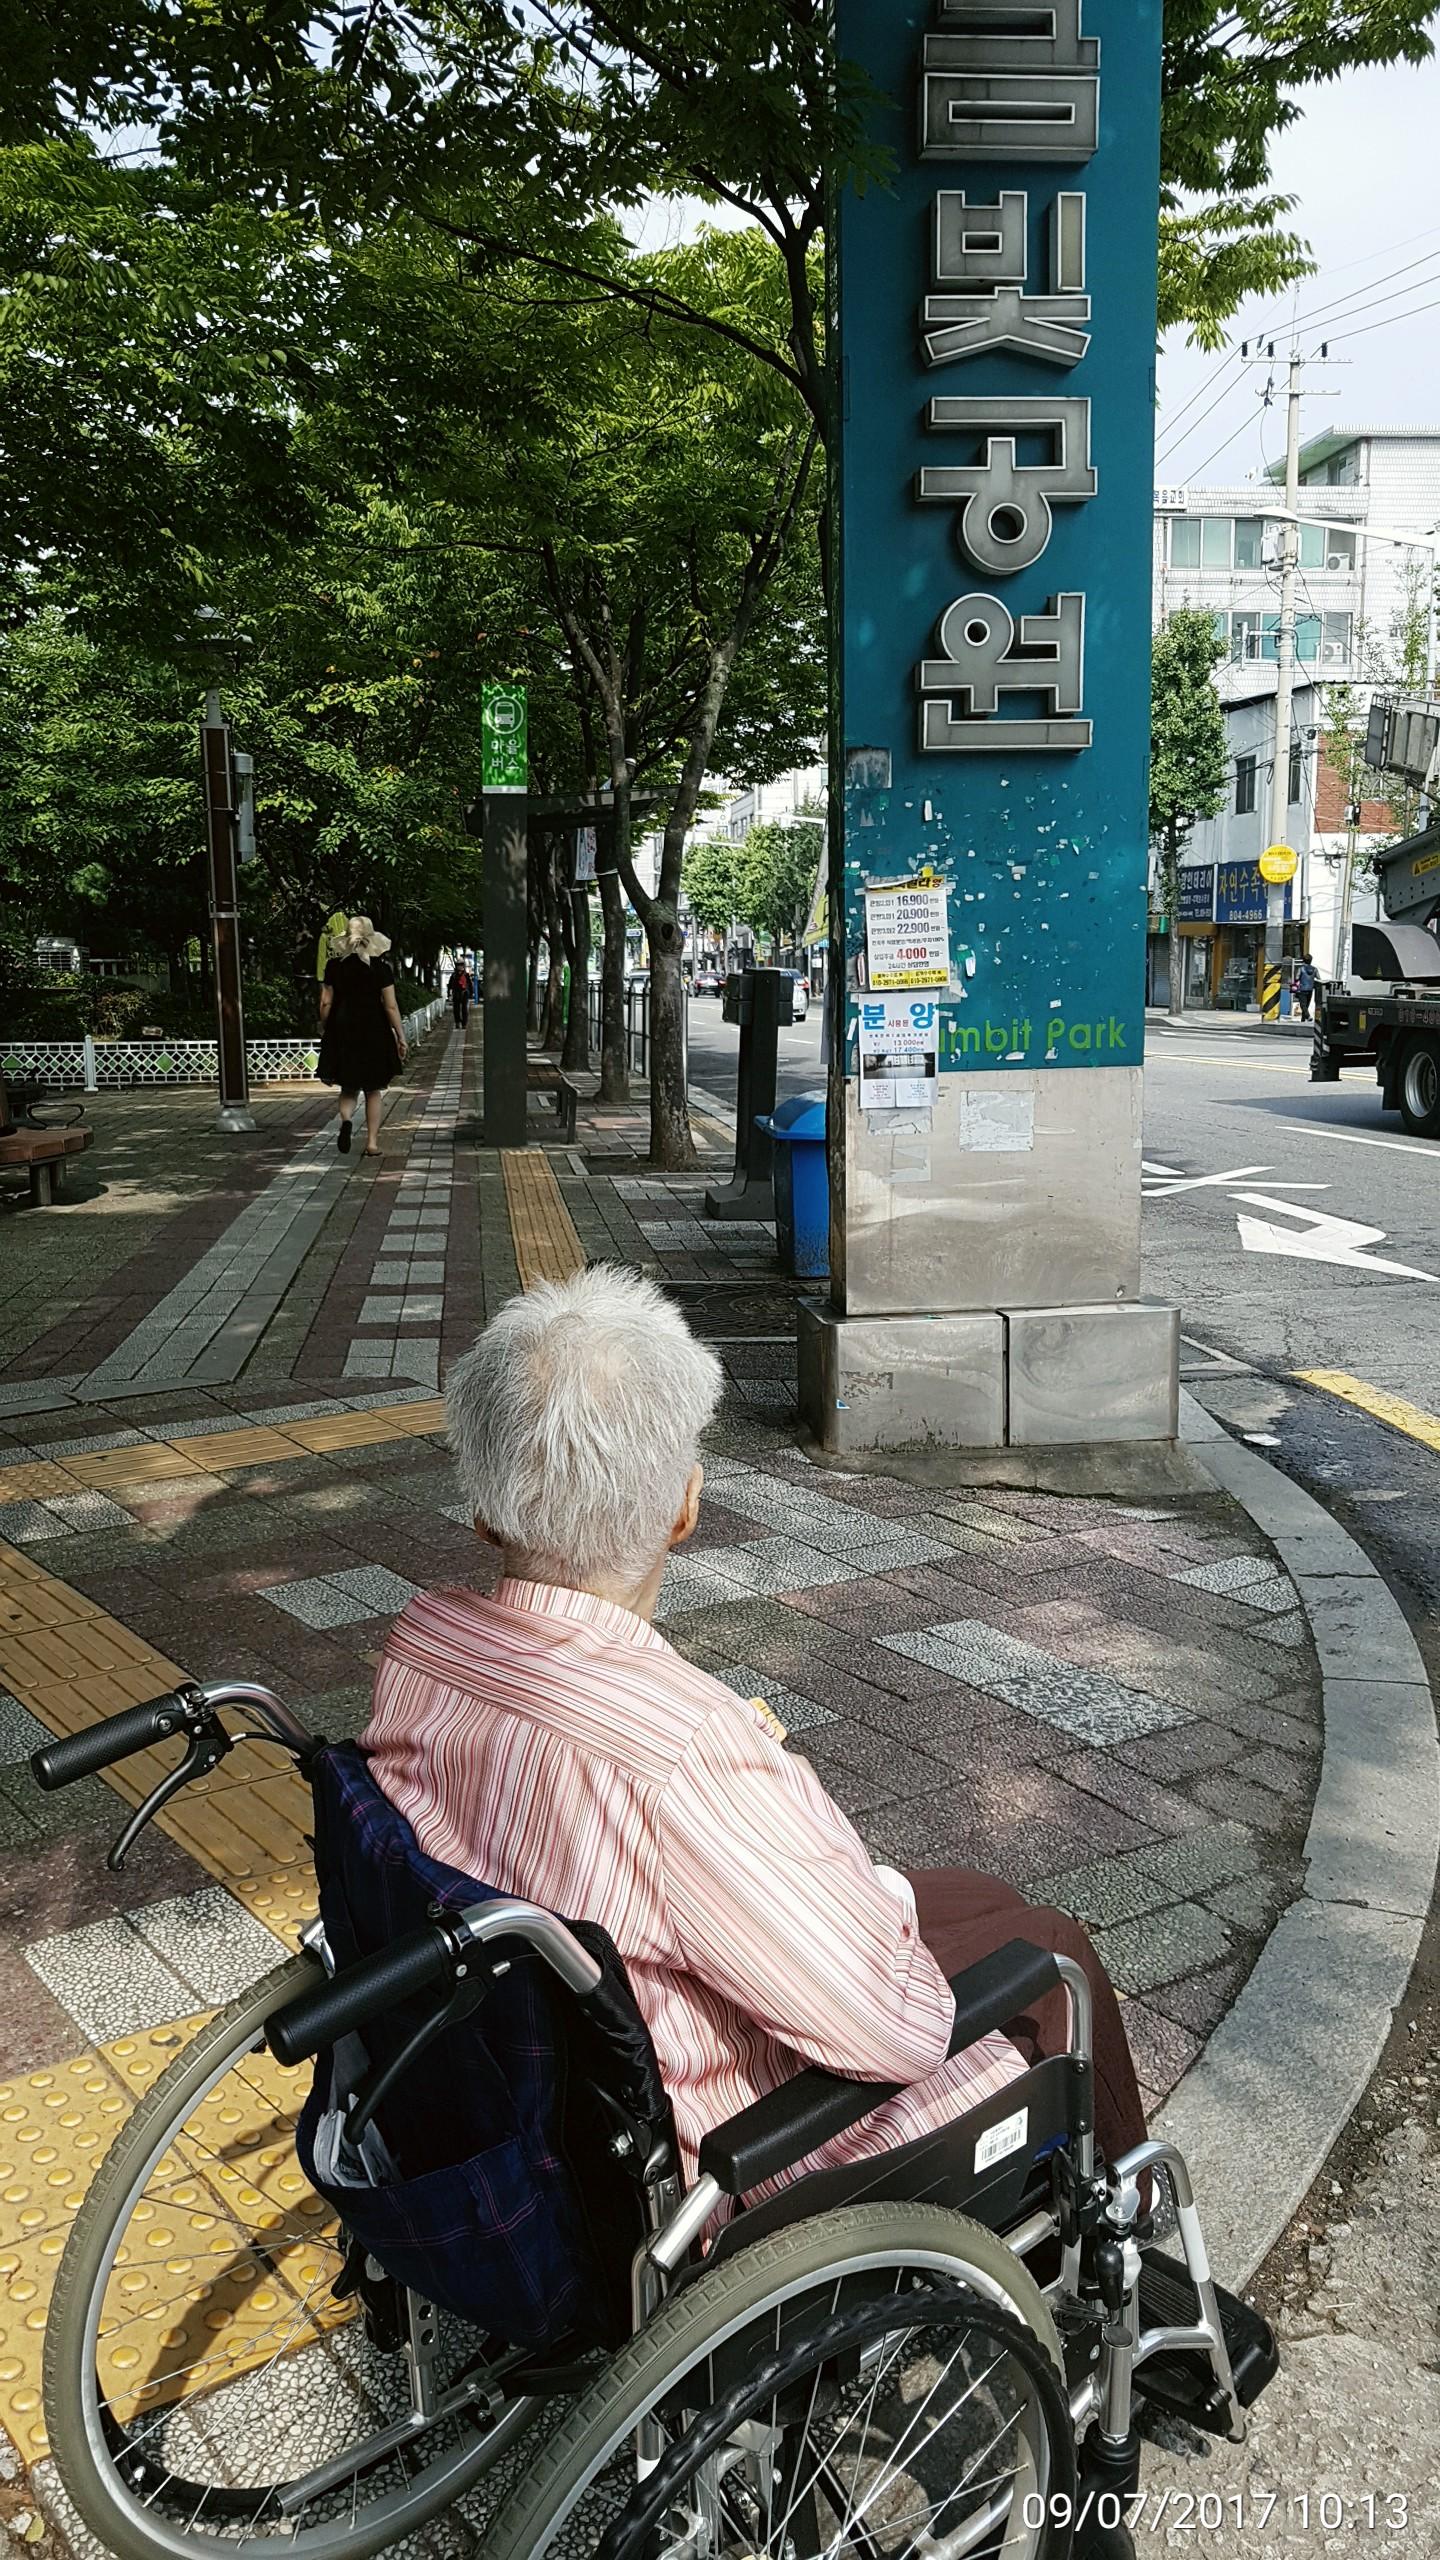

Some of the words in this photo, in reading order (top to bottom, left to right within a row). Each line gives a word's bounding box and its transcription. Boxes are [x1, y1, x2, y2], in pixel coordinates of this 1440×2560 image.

[491, 737, 520, 754] 마을
[491, 756, 520, 771] 버스
[1219, 867, 1269, 904] 자연수족
[862, 1003, 886, 1030] 분
[909, 1002, 935, 1030] 양
[1047, 1016, 1128, 1050] Park
